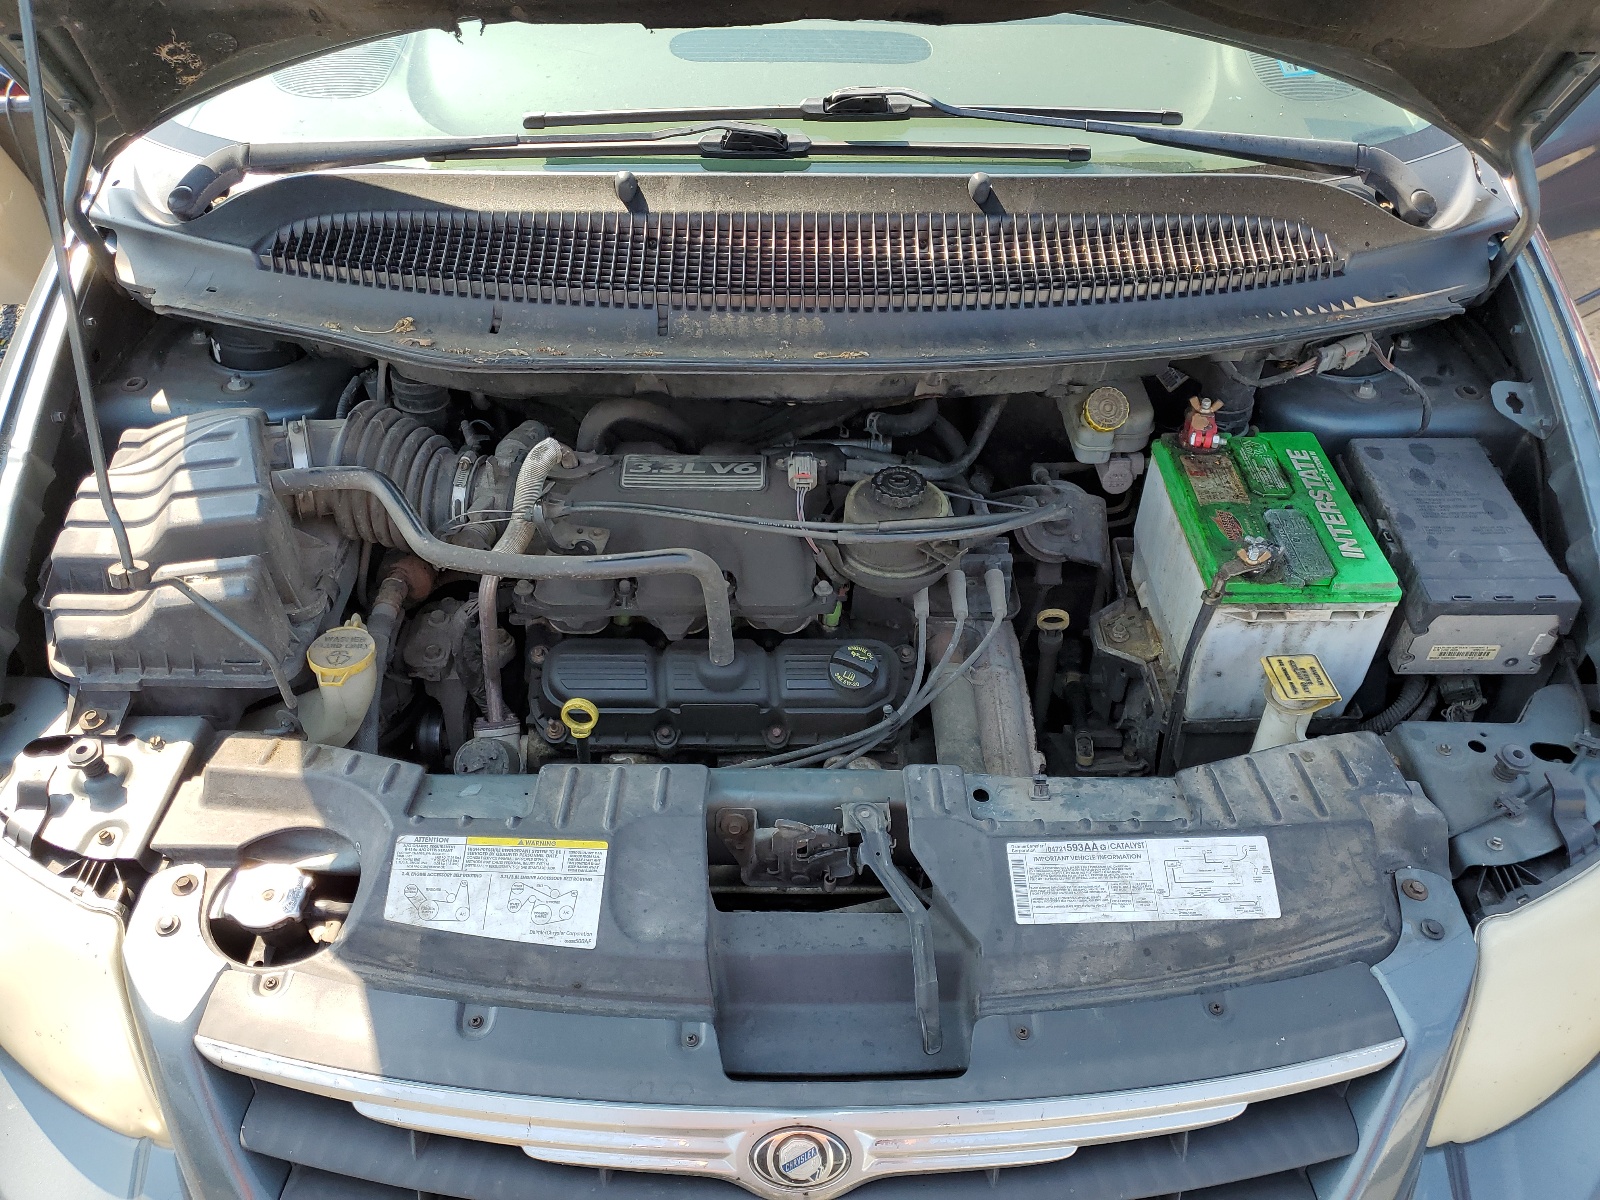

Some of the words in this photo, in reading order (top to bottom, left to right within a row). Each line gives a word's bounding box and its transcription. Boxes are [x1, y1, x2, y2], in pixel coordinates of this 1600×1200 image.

[629, 462, 706, 474] 3.3L
[711, 462, 758, 474] V6
[1286, 448, 1366, 559] INTERSTATE
[1109, 841, 1145, 850] CATALYST
[785, 1148, 816, 1172] CHRYSLER
